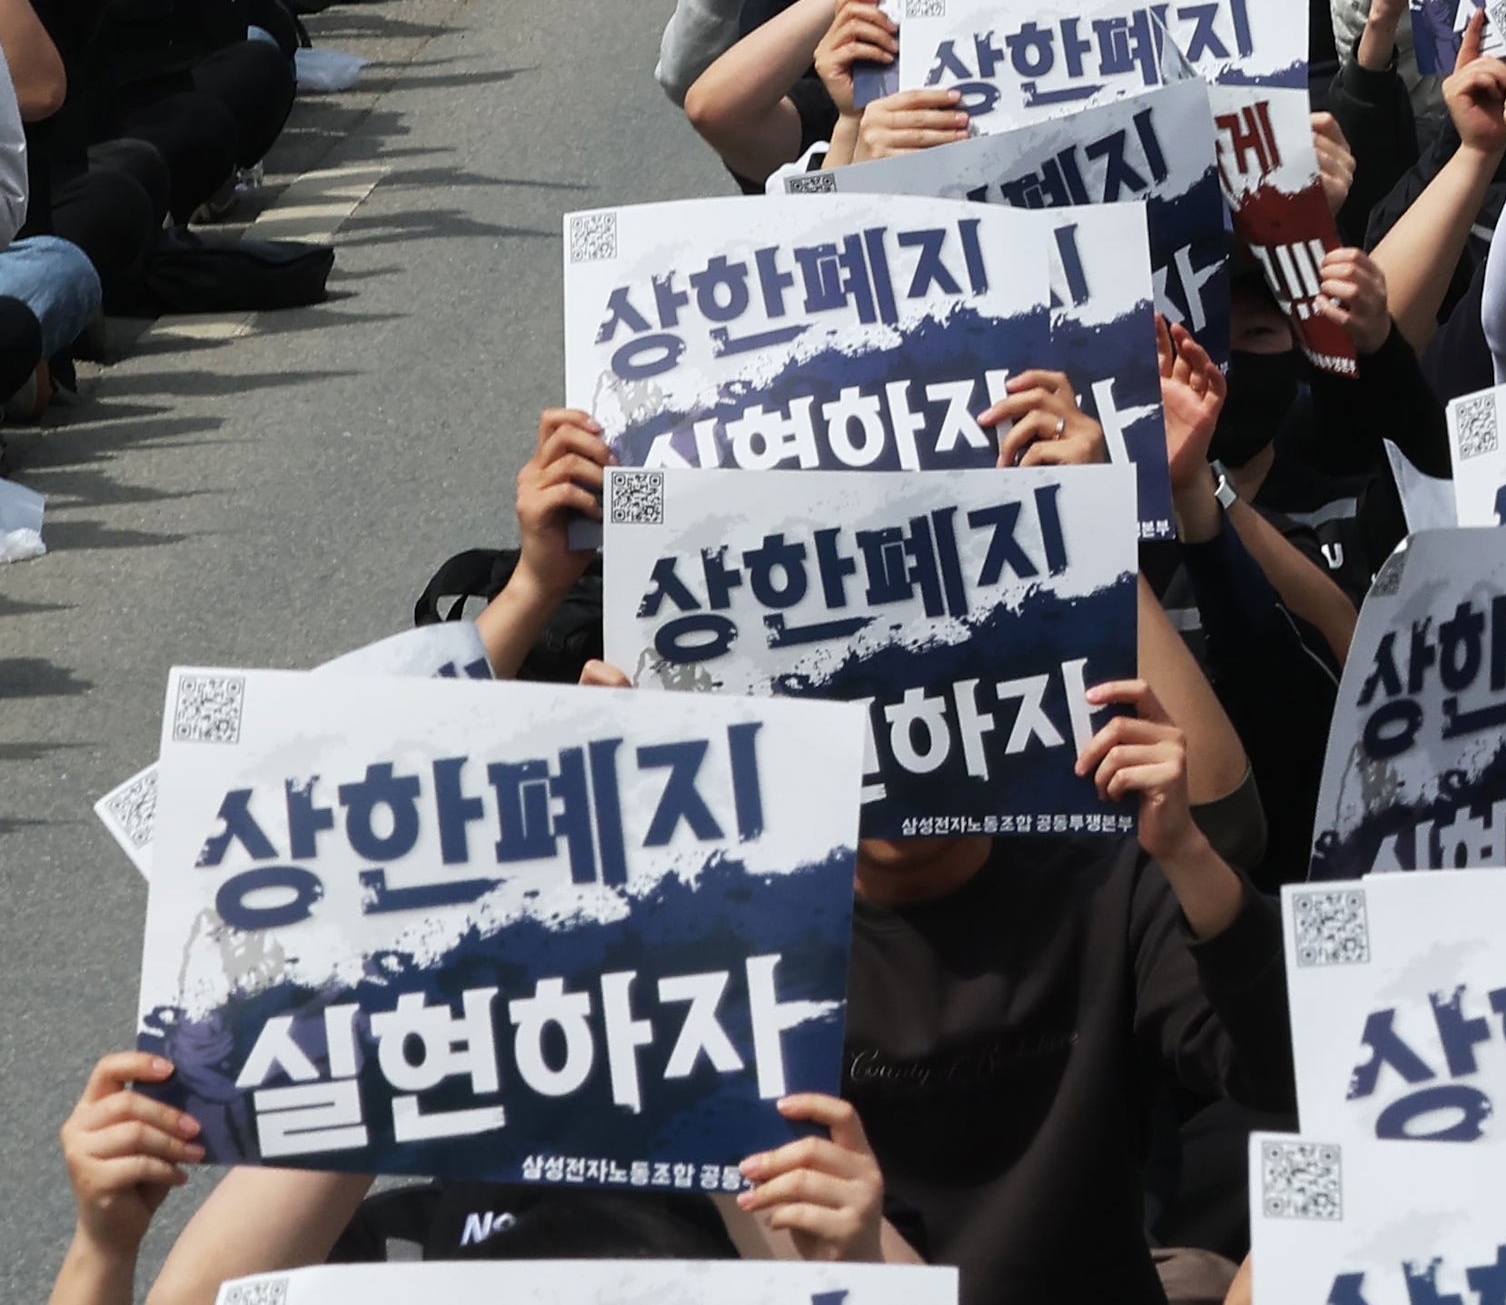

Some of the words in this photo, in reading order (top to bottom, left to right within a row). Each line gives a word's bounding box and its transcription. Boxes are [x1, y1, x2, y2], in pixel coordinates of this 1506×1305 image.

[594, 218, 989, 381] 상한폐지
[636, 483, 1067, 663] 상한폐지
[863, 657, 1104, 805] 하자
[195, 723, 764, 931] 상한폐지
[901, 815, 1032, 836] 삼성전자노동조합
[1035, 813, 1133, 834] 공동투쟁본부
[236, 954, 846, 1159] 실현하자
[522, 1154, 695, 1187] 삼성전자노동조합
